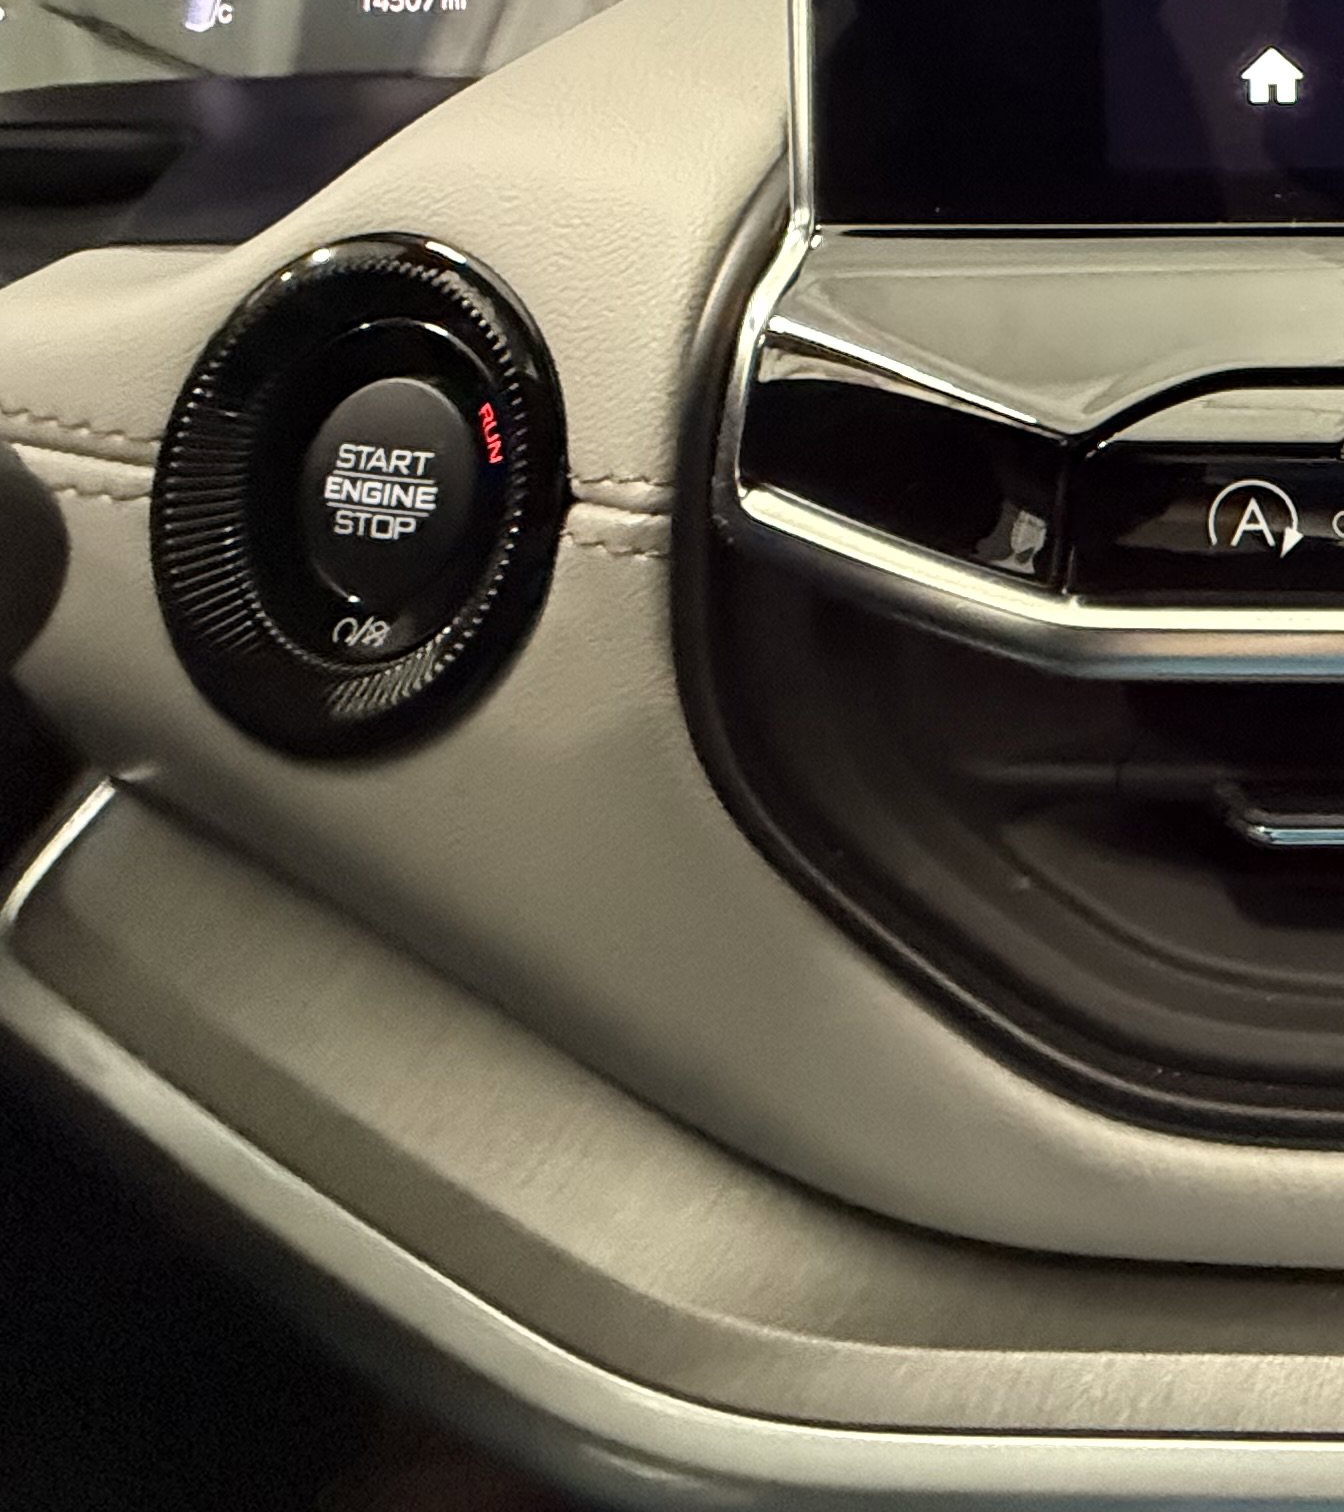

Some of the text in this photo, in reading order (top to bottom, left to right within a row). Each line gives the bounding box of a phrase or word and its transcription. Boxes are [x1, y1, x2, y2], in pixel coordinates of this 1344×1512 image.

[217, 4, 232, 23] C
[478, 402, 503, 464] RUN
[336, 444, 434, 475] START
[324, 477, 439, 510] ENGINE
[333, 511, 416, 539] STOP
